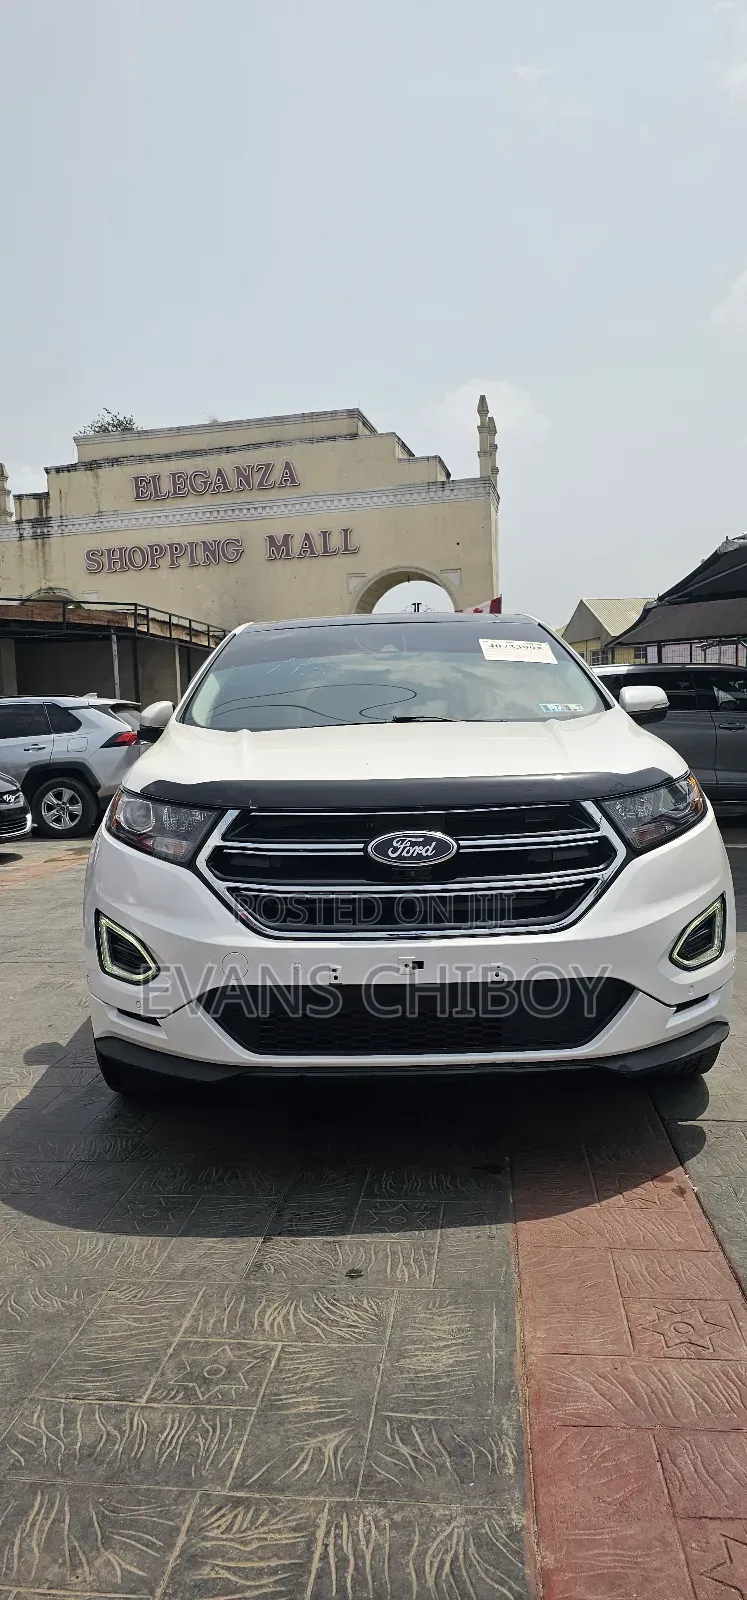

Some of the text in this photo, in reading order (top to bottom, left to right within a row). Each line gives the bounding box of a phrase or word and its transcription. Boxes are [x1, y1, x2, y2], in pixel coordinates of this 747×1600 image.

[131, 460, 300, 502] ELEGANZA
[85, 528, 360, 574] SHOPPING MALL
[387, 837, 437, 858] Ford
